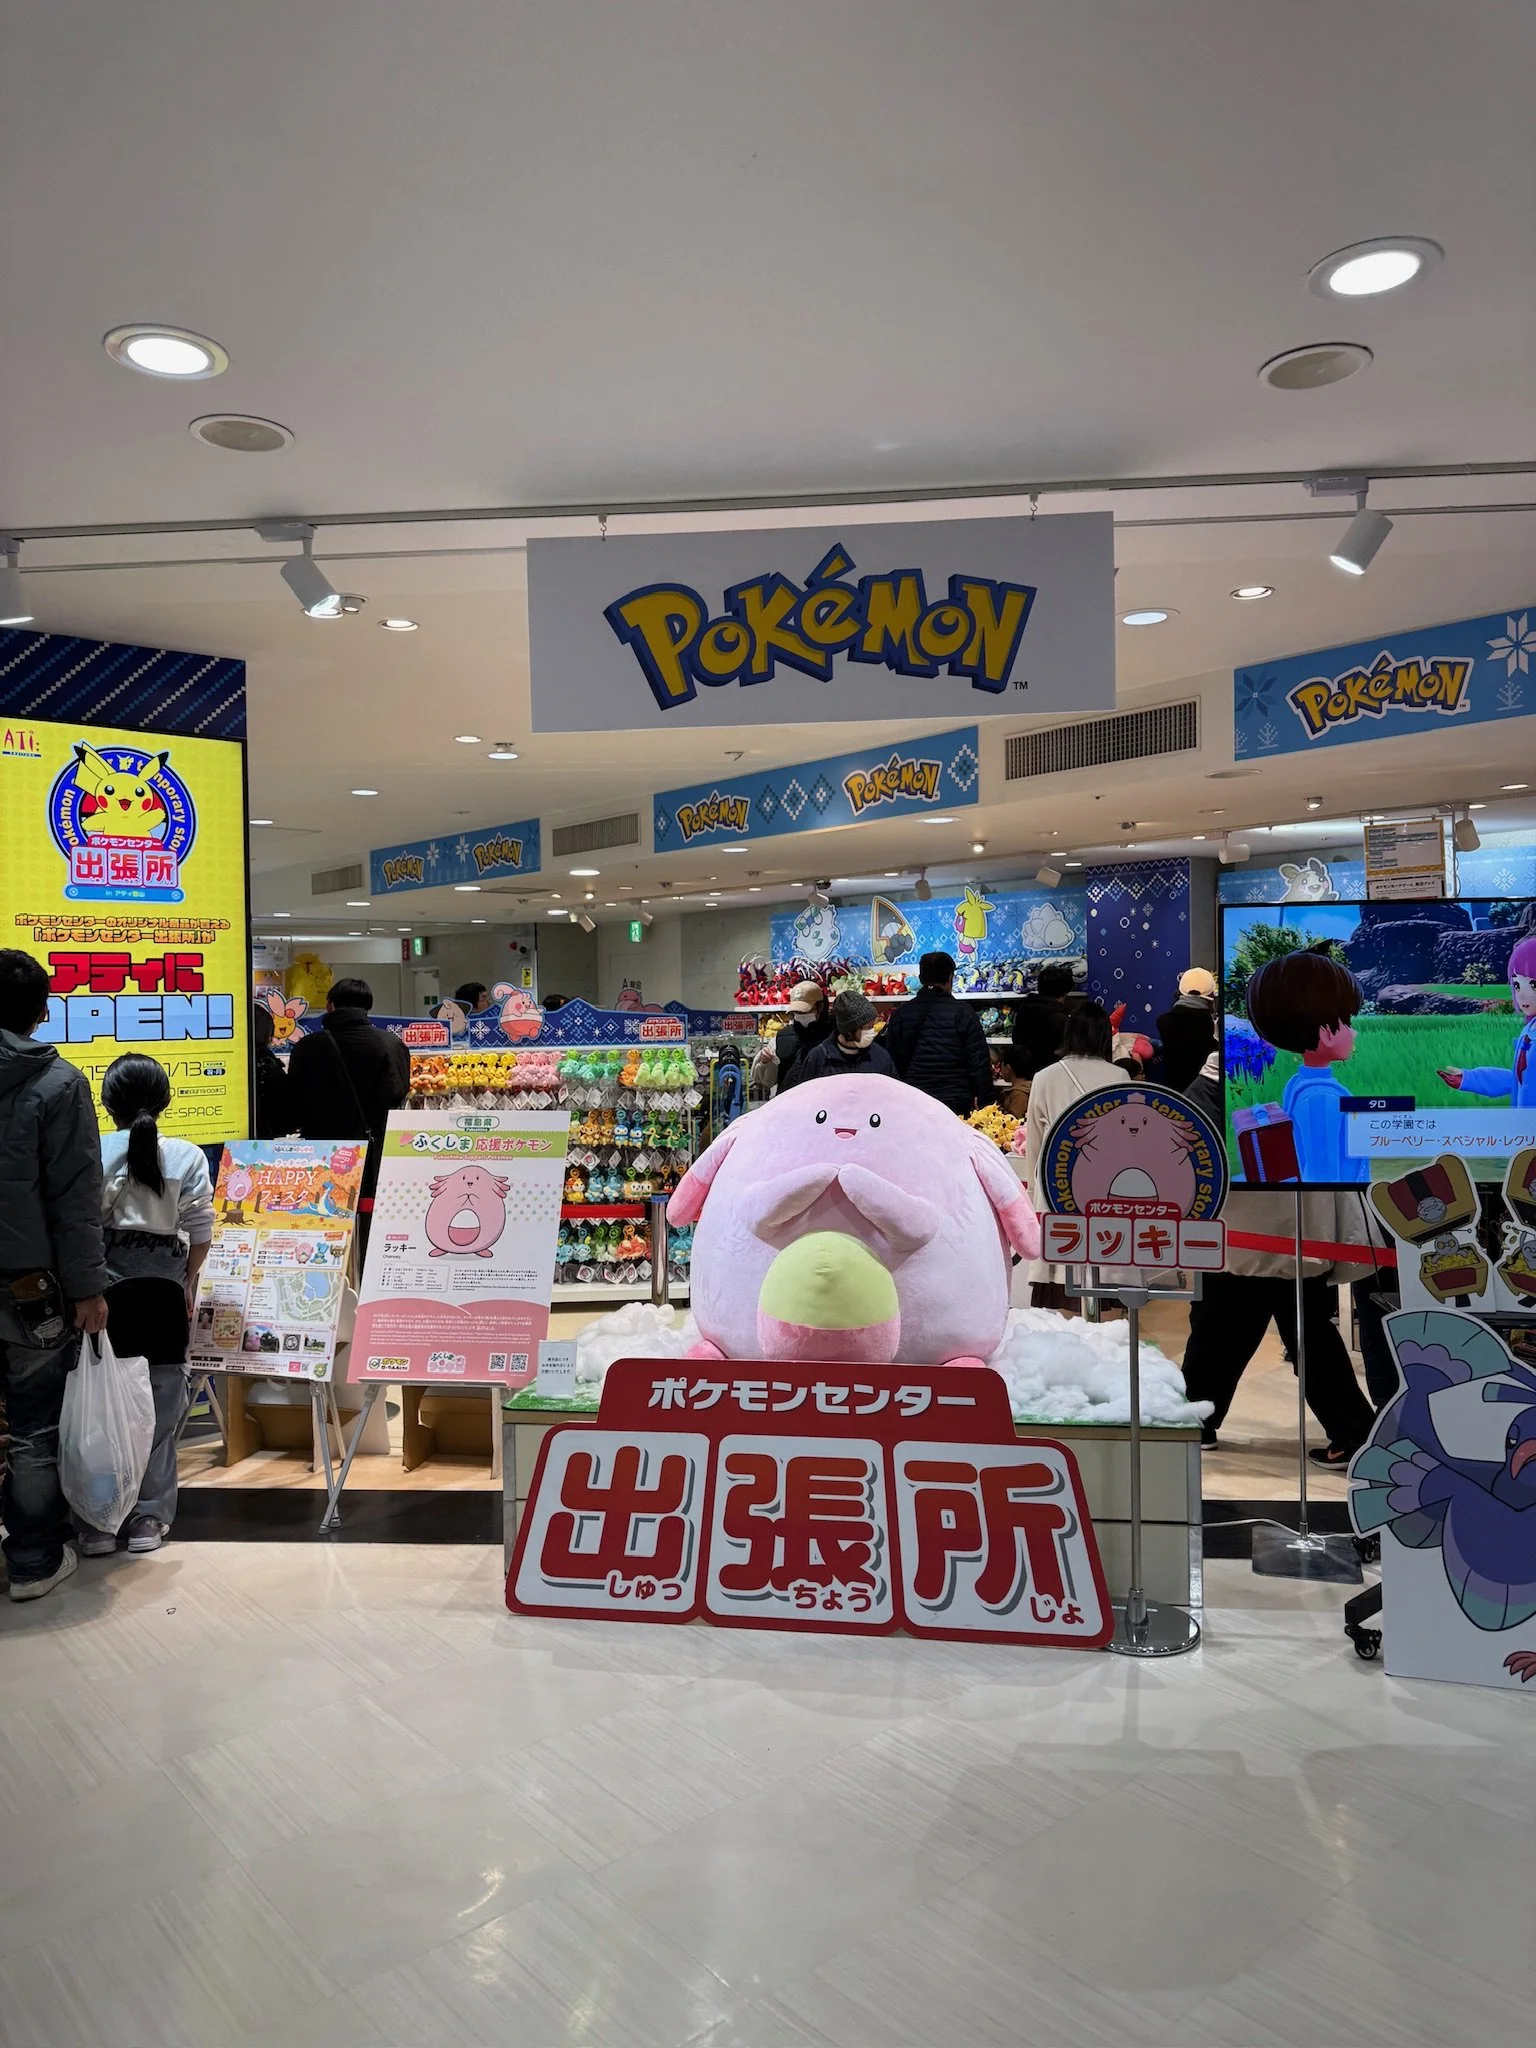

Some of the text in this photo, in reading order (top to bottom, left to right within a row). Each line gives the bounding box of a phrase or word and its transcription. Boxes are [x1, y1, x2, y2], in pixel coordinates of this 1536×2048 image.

[91, 837, 162, 848] ポケモンセンター
[76, 851, 173, 882] 出張所
[48, 952, 204, 992] アティに
[405, 1031, 446, 1042] 出張所
[642, 1025, 682, 1037] 出張所
[463, 1117, 493, 1127] 福島県
[1369, 1119, 1437, 1130] この学園では
[257, 1170, 319, 1186] HAPPY
[260, 1189, 309, 1204] フェスタ
[1089, 1203, 1179, 1216] ポケモンセンター
[384, 1243, 417, 1252] ラッキー
[1050, 1222, 1219, 1261] ラッキー
[648, 1377, 977, 1416] ポケモンセンター
[540, 1445, 1072, 1610] 出張所
[606, 1574, 1086, 1626] しゅっ ちょう じょ
